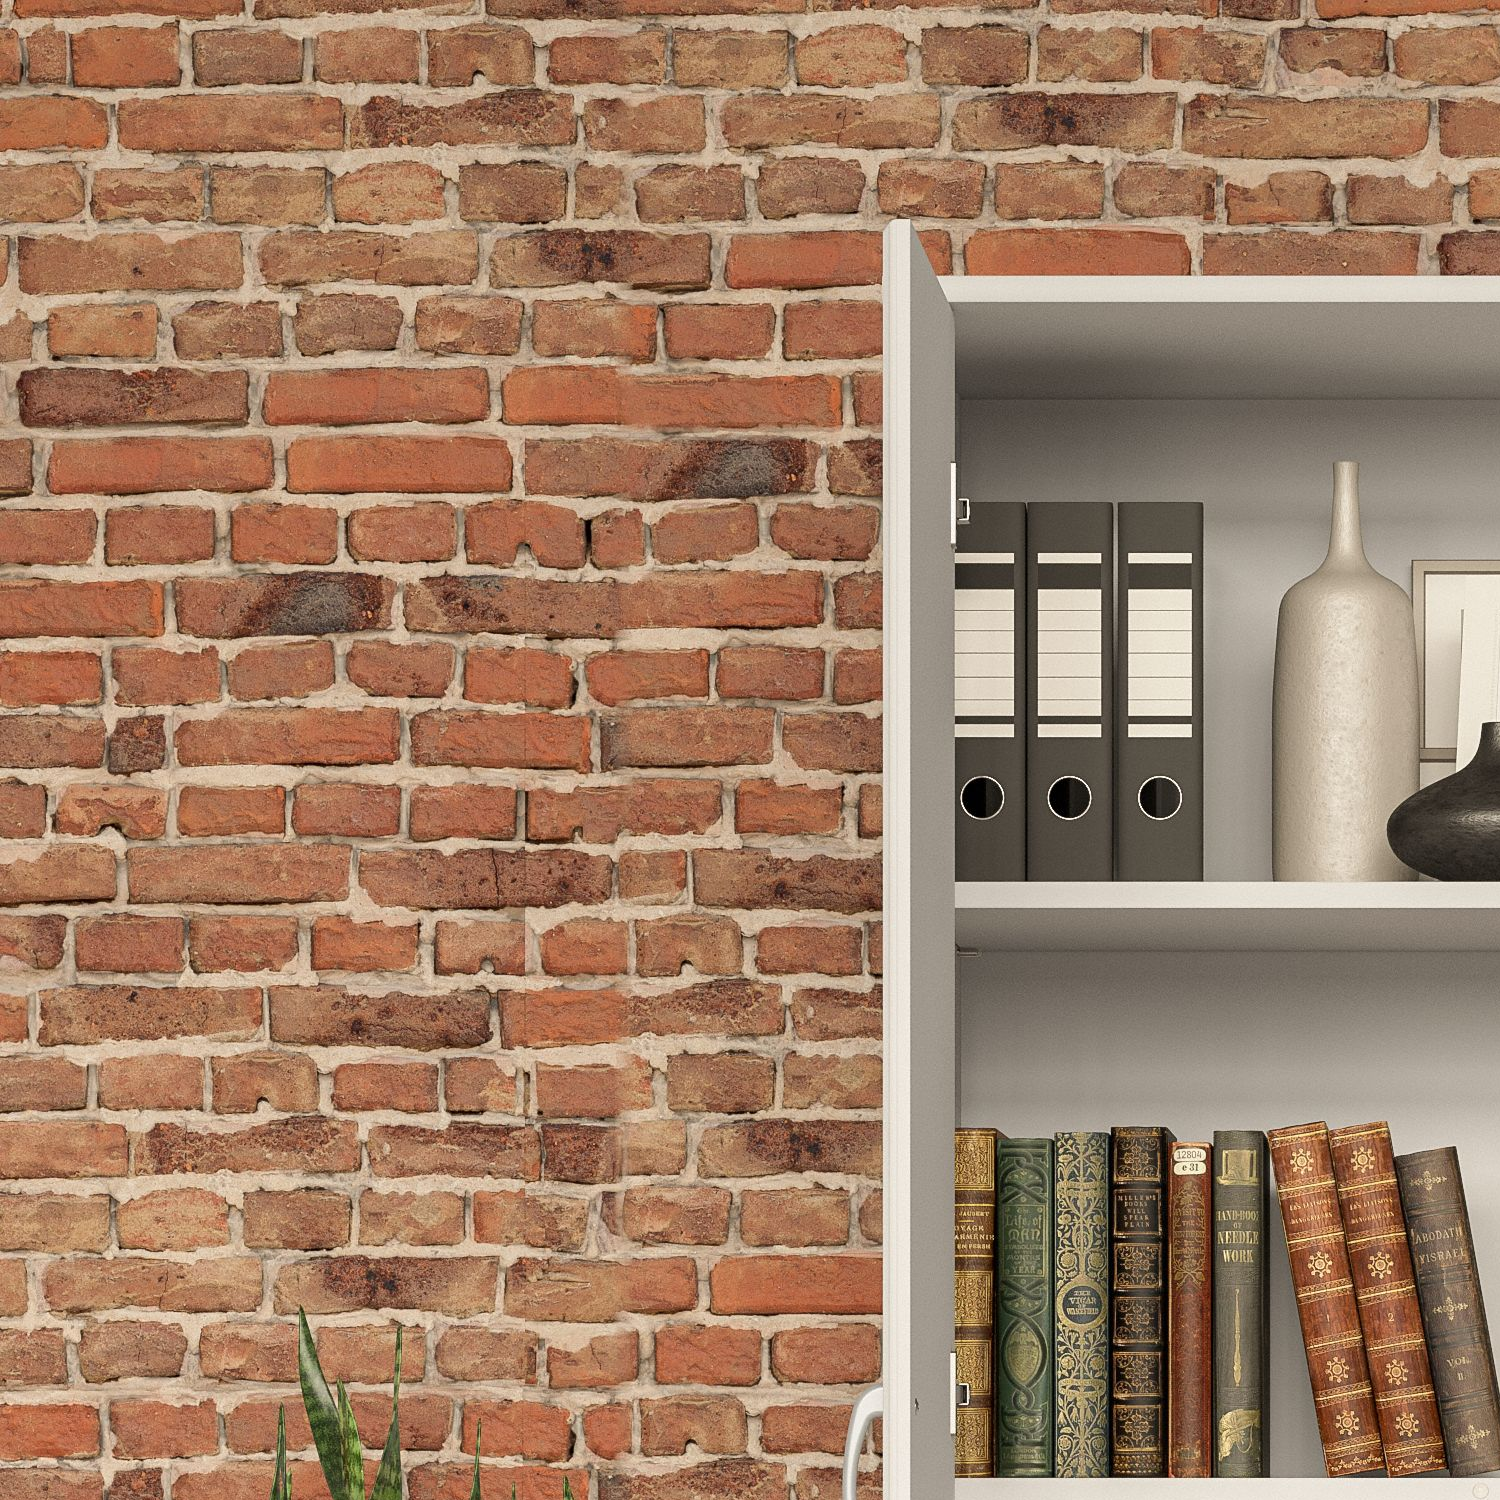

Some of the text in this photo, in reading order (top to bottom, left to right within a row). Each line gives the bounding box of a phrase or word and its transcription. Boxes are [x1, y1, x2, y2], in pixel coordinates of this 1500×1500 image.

[1176, 1150, 1202, 1160] 12804
[1182, 1162, 1199, 1172] e 31
[1217, 1230, 1259, 1245] NEEDLE
[1222, 1249, 1254, 1263] WORK
[1419, 1247, 1467, 1264] YISRAEL
[1068, 1296, 1098, 1305] VICAR
[1387, 1312, 1395, 1322] 2
